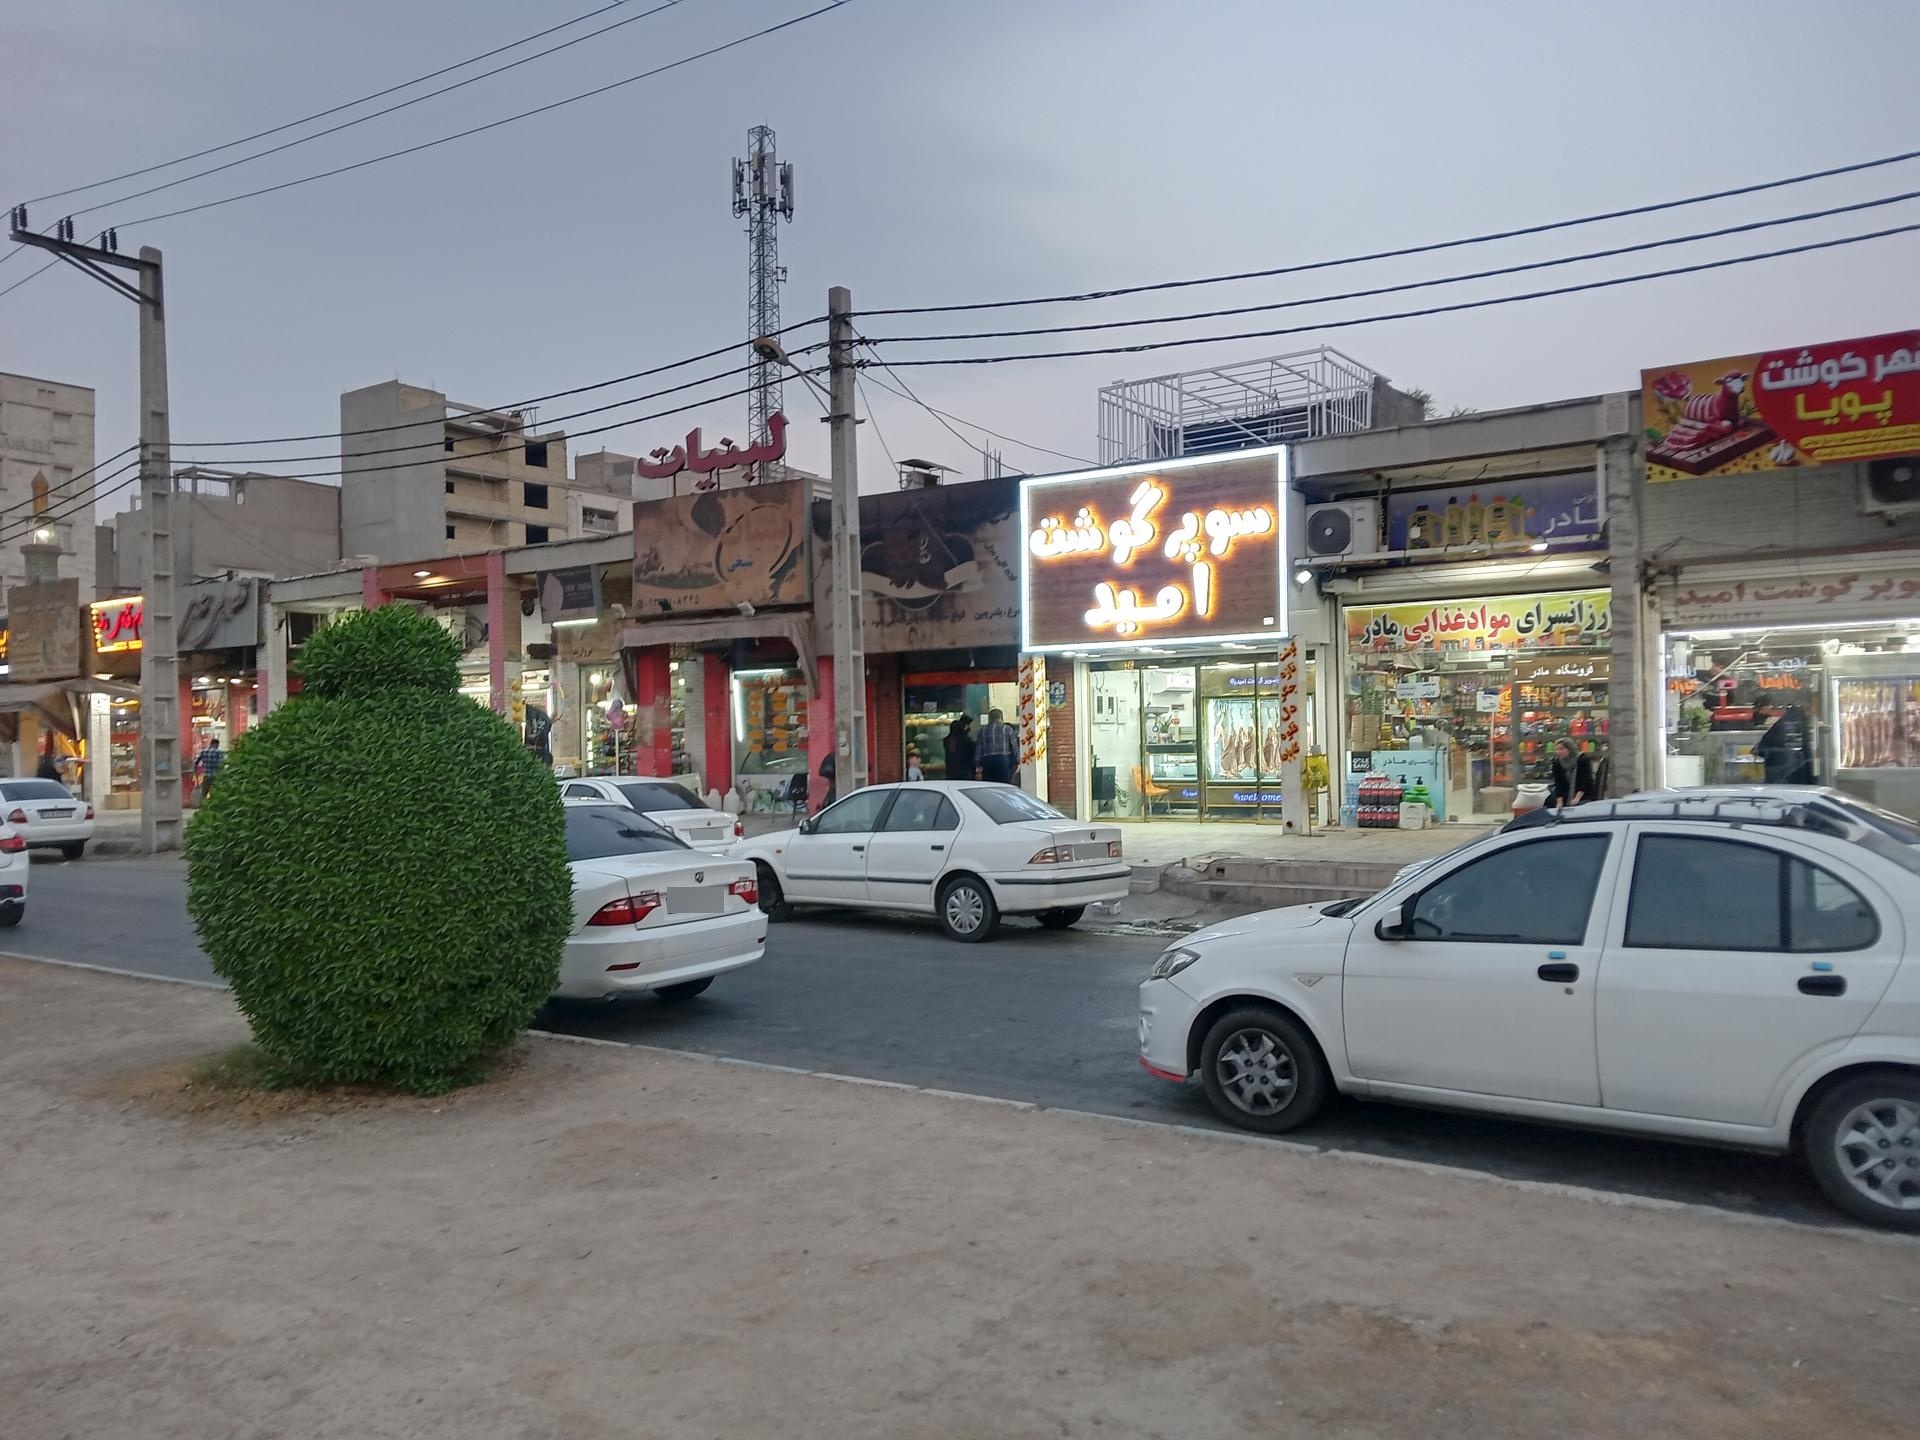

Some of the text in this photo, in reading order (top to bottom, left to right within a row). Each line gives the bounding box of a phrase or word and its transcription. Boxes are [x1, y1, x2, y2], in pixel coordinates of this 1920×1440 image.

[1761, 348, 1920, 391] هر گوشت
[1795, 389, 1893, 426] پویا
[637, 410, 789, 490] لبنیات
[1029, 480, 1163, 565] گوشت
[1164, 507, 1272, 563] سوپر
[1543, 505, 1601, 535] ادر
[1084, 561, 1210, 634] امید
[1360, 612, 1399, 645] مادر
[1530, 662, 1594, 678] فروشگاه مادر
[1281, 705, 1298, 721] دل
